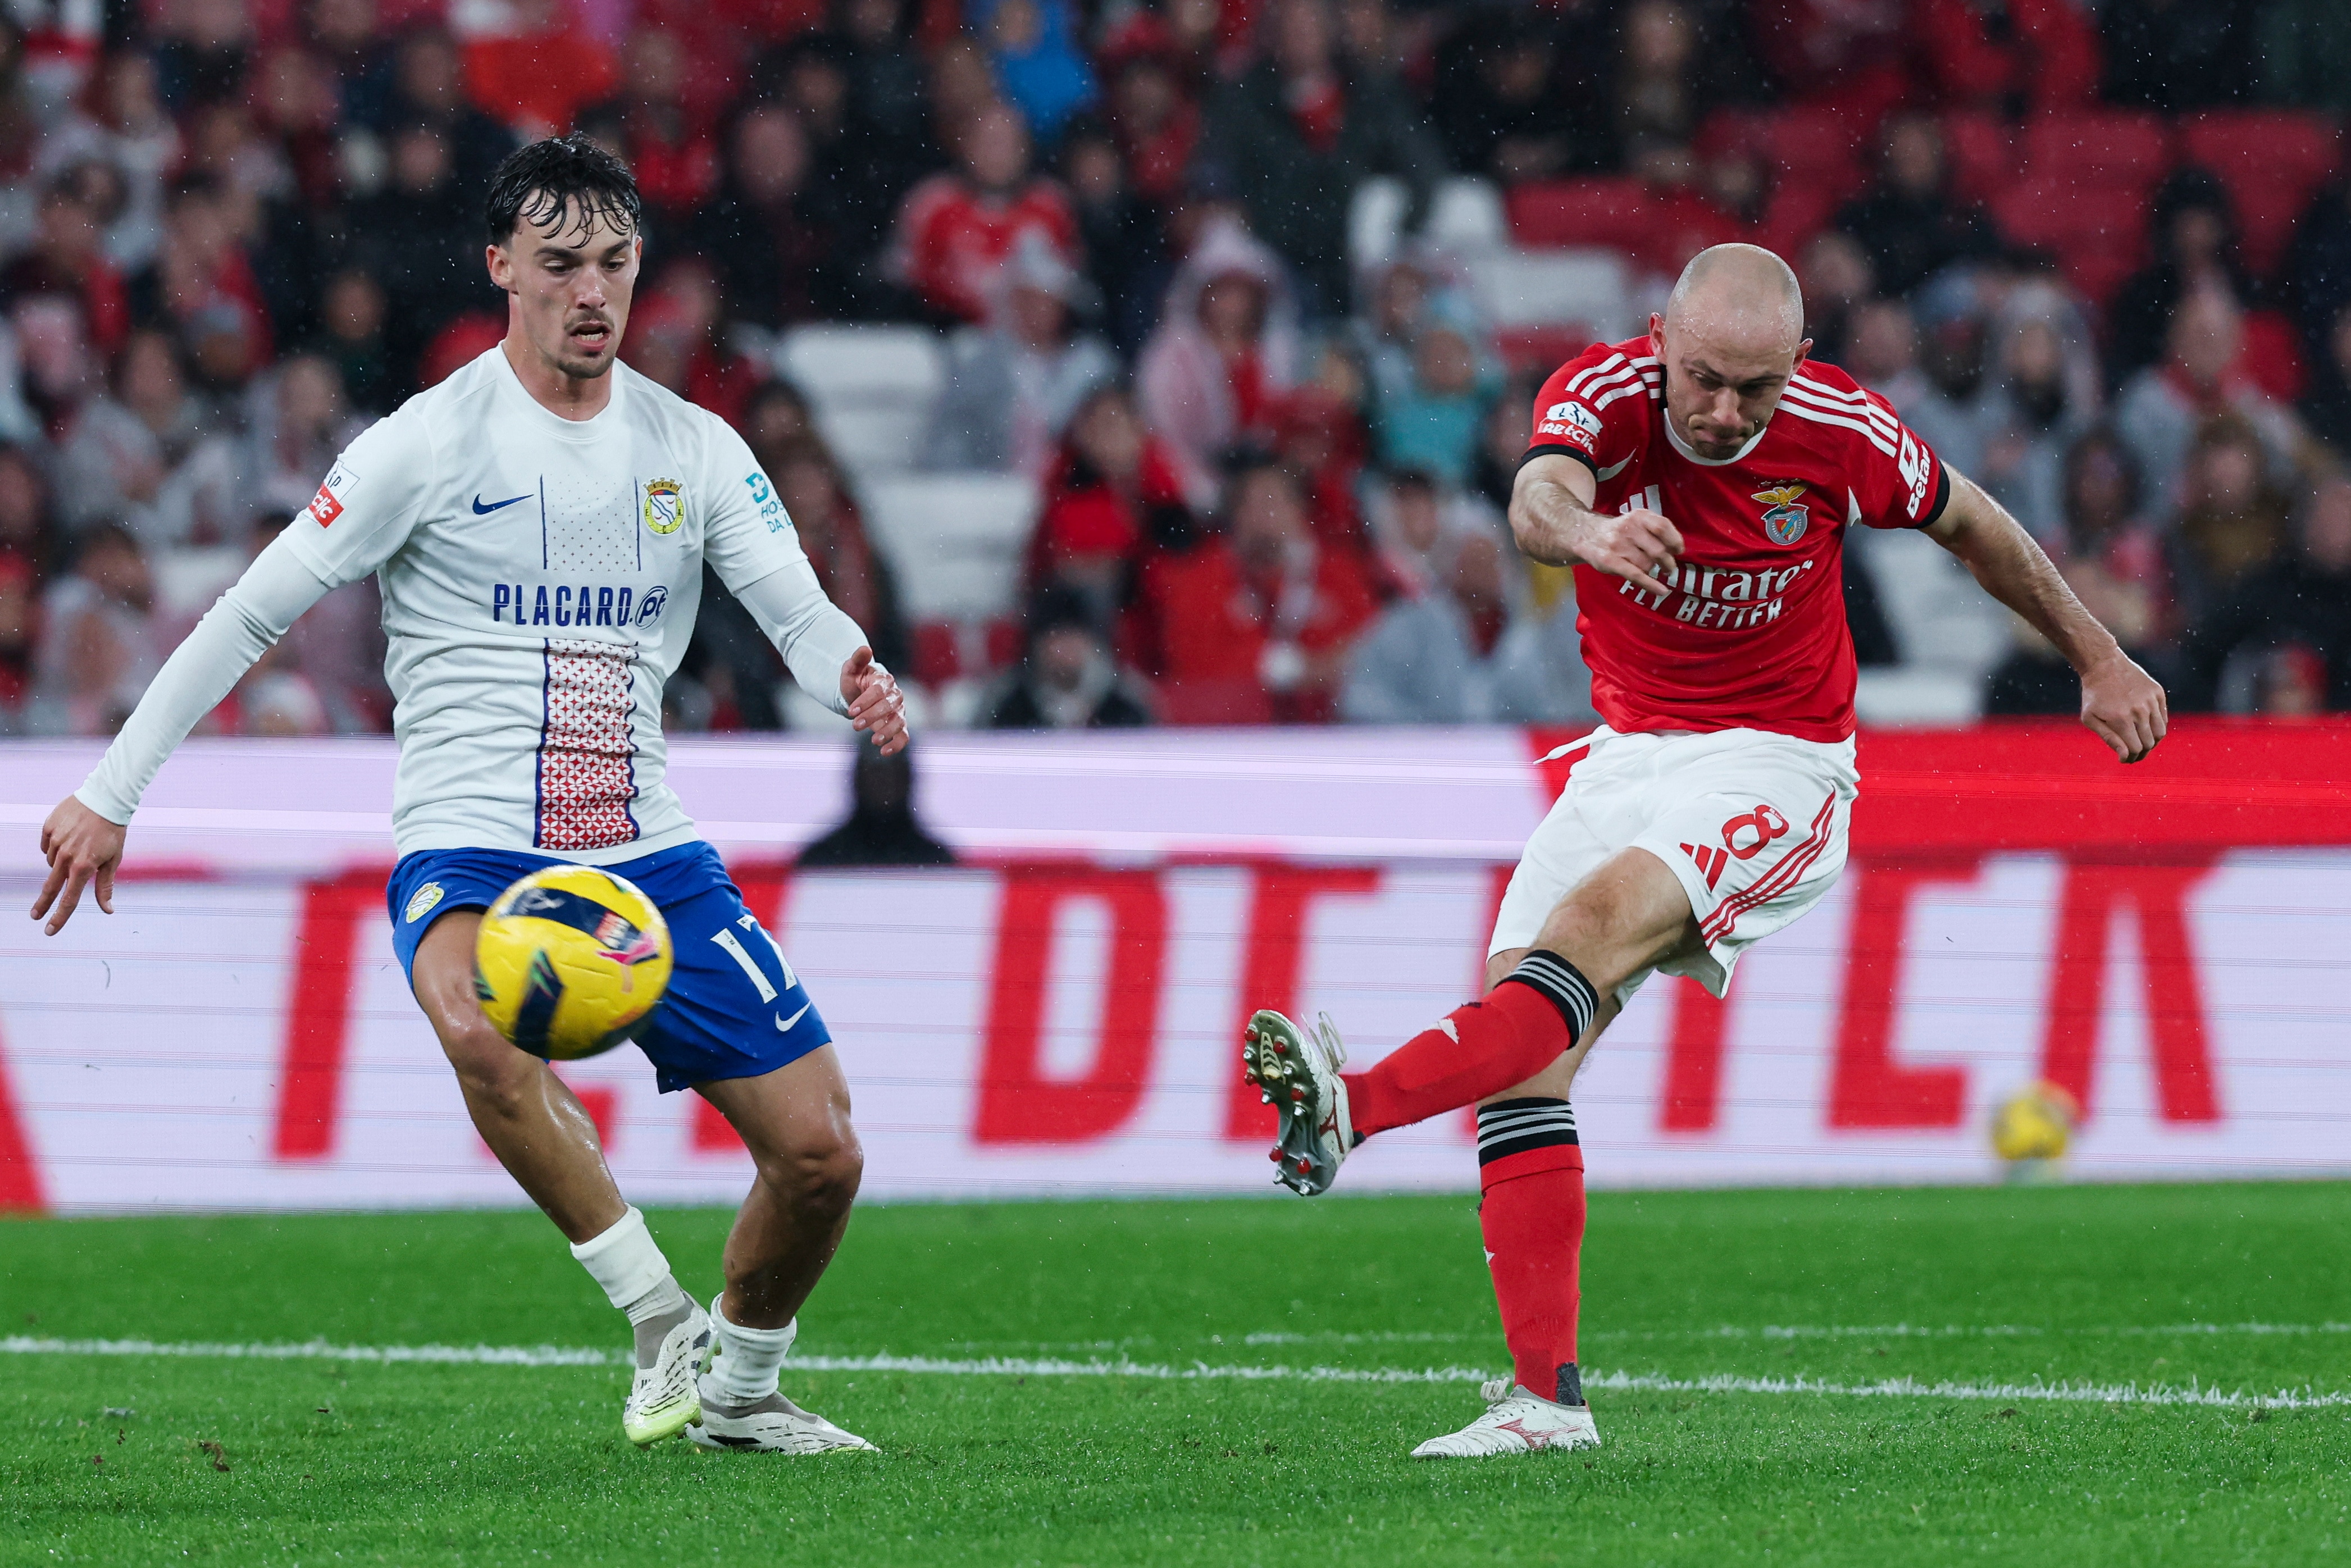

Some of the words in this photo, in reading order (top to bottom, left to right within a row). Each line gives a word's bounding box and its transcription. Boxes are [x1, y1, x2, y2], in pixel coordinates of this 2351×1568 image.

[311, 494, 334, 519] clic
[766, 517, 785, 534] DA
[1721, 804, 1790, 860] 8
[709, 914, 798, 1004] 17
